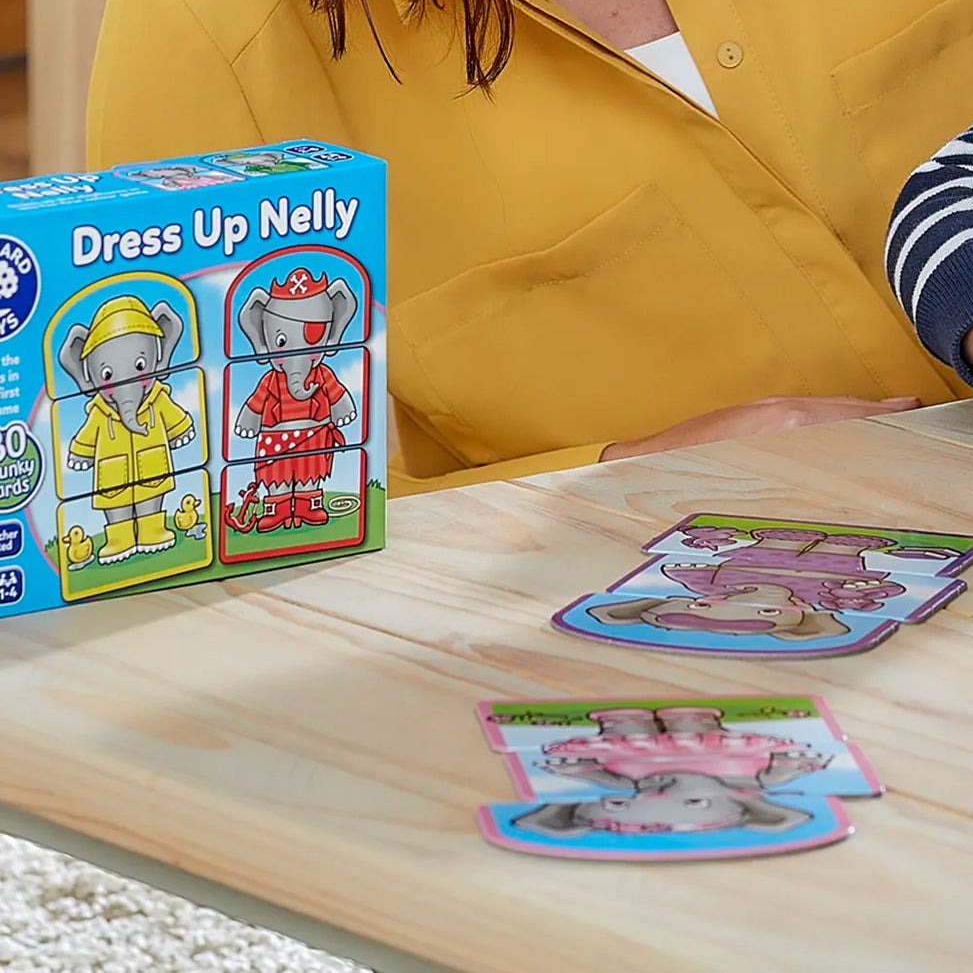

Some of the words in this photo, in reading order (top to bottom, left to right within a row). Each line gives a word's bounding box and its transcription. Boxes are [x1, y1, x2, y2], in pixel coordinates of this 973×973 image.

[73, 224, 182, 266] Dress
[193, 207, 248, 256] Up
[260, 188, 358, 239] Nelly
